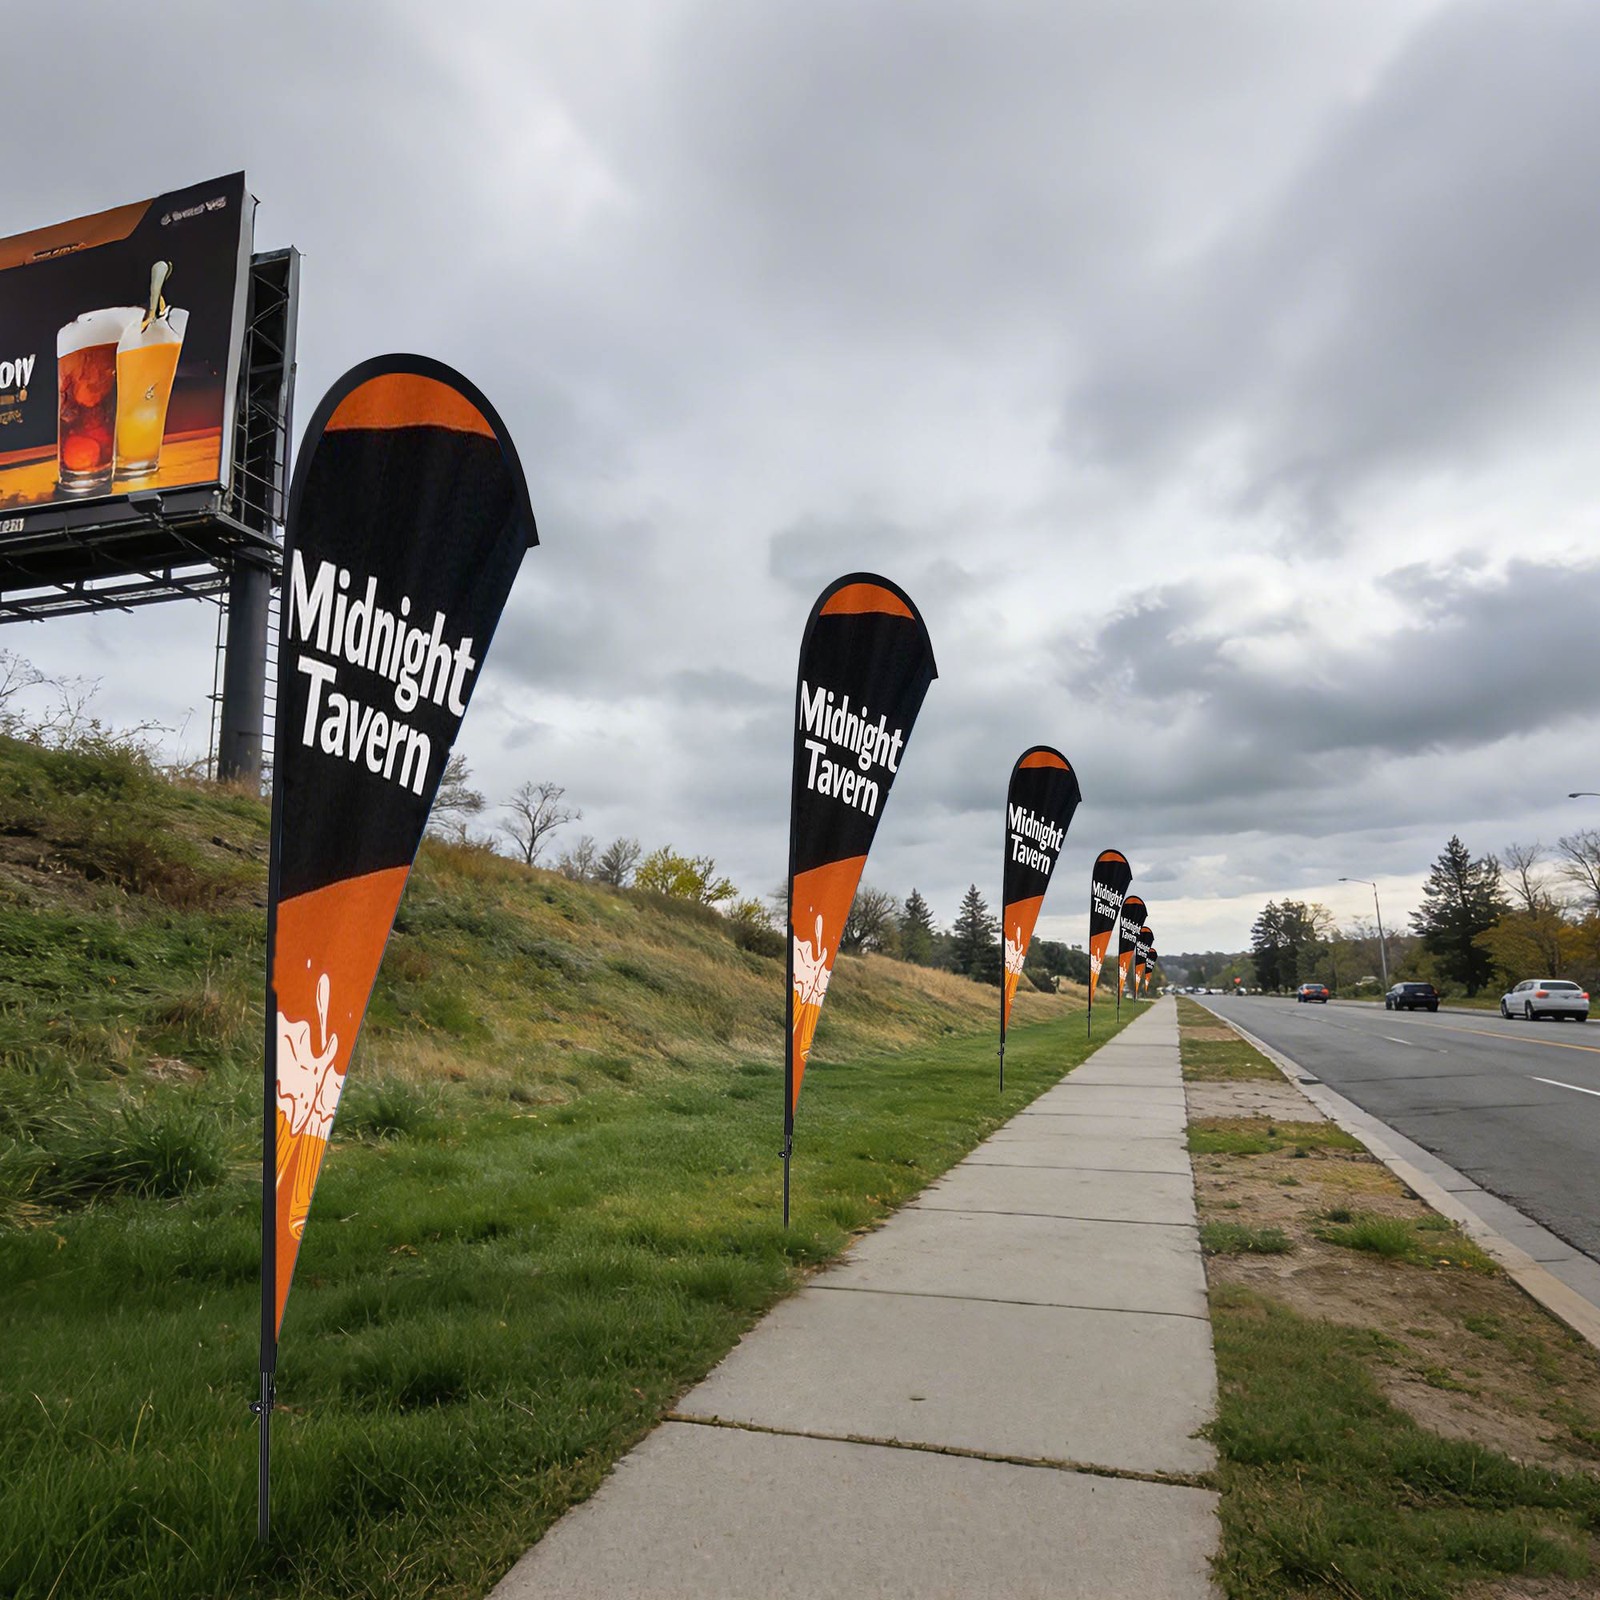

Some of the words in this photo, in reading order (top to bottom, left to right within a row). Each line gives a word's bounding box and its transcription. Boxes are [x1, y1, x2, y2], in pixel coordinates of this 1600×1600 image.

[287, 548, 475, 718] Midnight
[298, 655, 431, 796] Tavern
[799, 680, 903, 773] Midnight
[804, 738, 879, 816] Tavern
[1008, 802, 1063, 852] Midnight
[1011, 833, 1051, 875] Tavern
[1092, 880, 1123, 908] Midnight
[1094, 897, 1116, 920] Tavern
